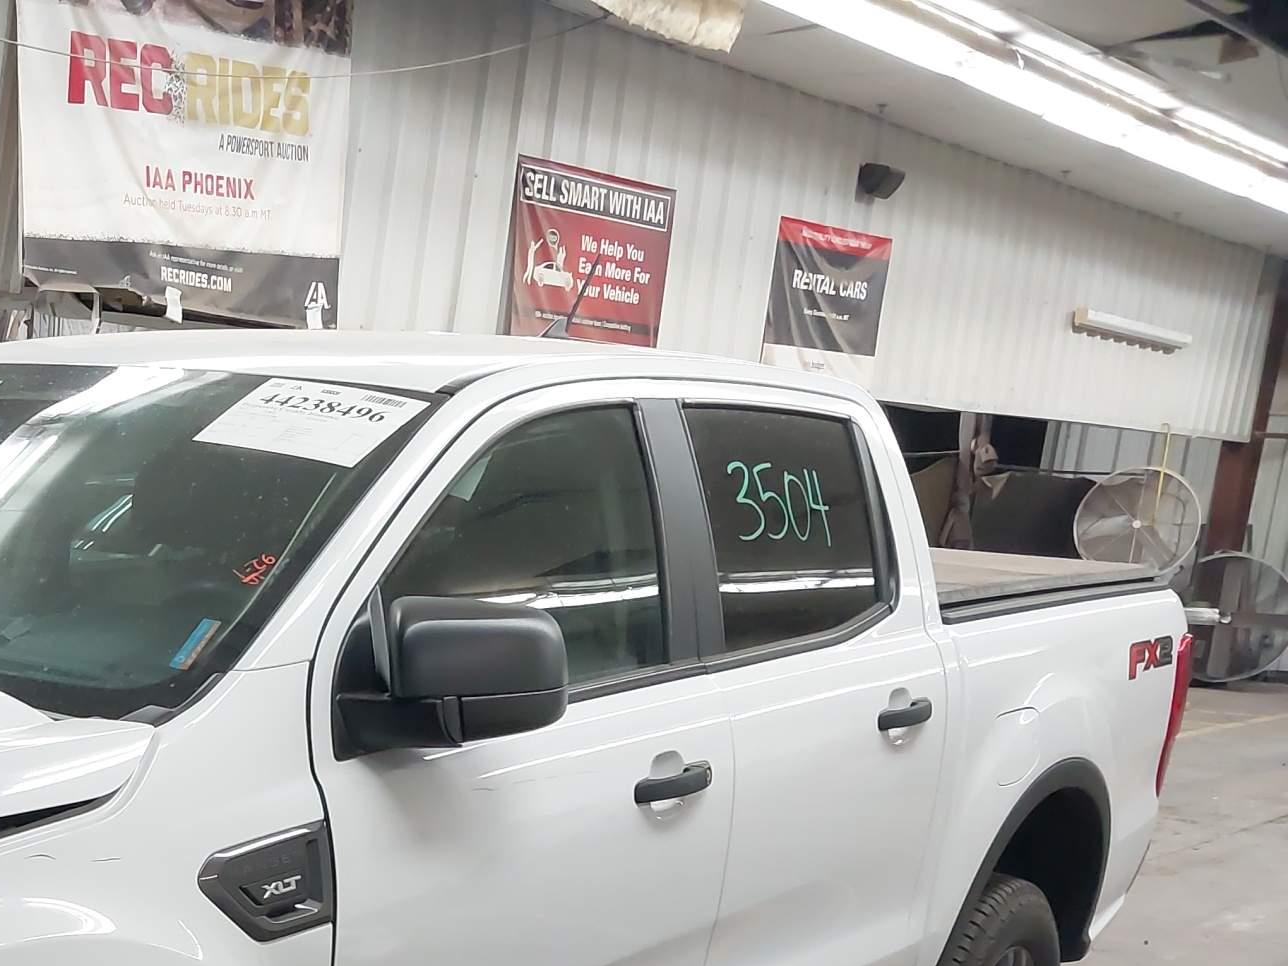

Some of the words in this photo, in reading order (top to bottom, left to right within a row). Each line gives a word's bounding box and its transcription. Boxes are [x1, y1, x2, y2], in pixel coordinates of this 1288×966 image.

[67, 30, 176, 116] REC
[184, 51, 312, 137] RIDES
[219, 133, 224, 151] A
[226, 134, 274, 158] POWERSPORT
[276, 142, 309, 162] AUCTION
[145, 165, 176, 192] IAA
[182, 170, 255, 200] PHOENIX
[525, 171, 556, 202] SELL
[560, 179, 608, 212] SMART
[609, 190, 641, 220] WITH
[643, 198, 664, 225] IAA
[581, 235, 597, 253] We
[600, 239, 623, 261] Help
[626, 243, 644, 262] You
[160, 266, 232, 292] RECRIDES.COM
[578, 257, 602, 276] Ean
[605, 262, 631, 281] More
[633, 267, 650, 284] For
[792, 269, 836, 296] RENTAL
[839, 280, 868, 300] CARS
[603, 283, 640, 304] Vehicle
[261, 393, 393, 422] 44238496
[727, 461, 832, 547] 3504
[1128, 635, 1173, 680] FX2
[261, 875, 302, 899] XLT
